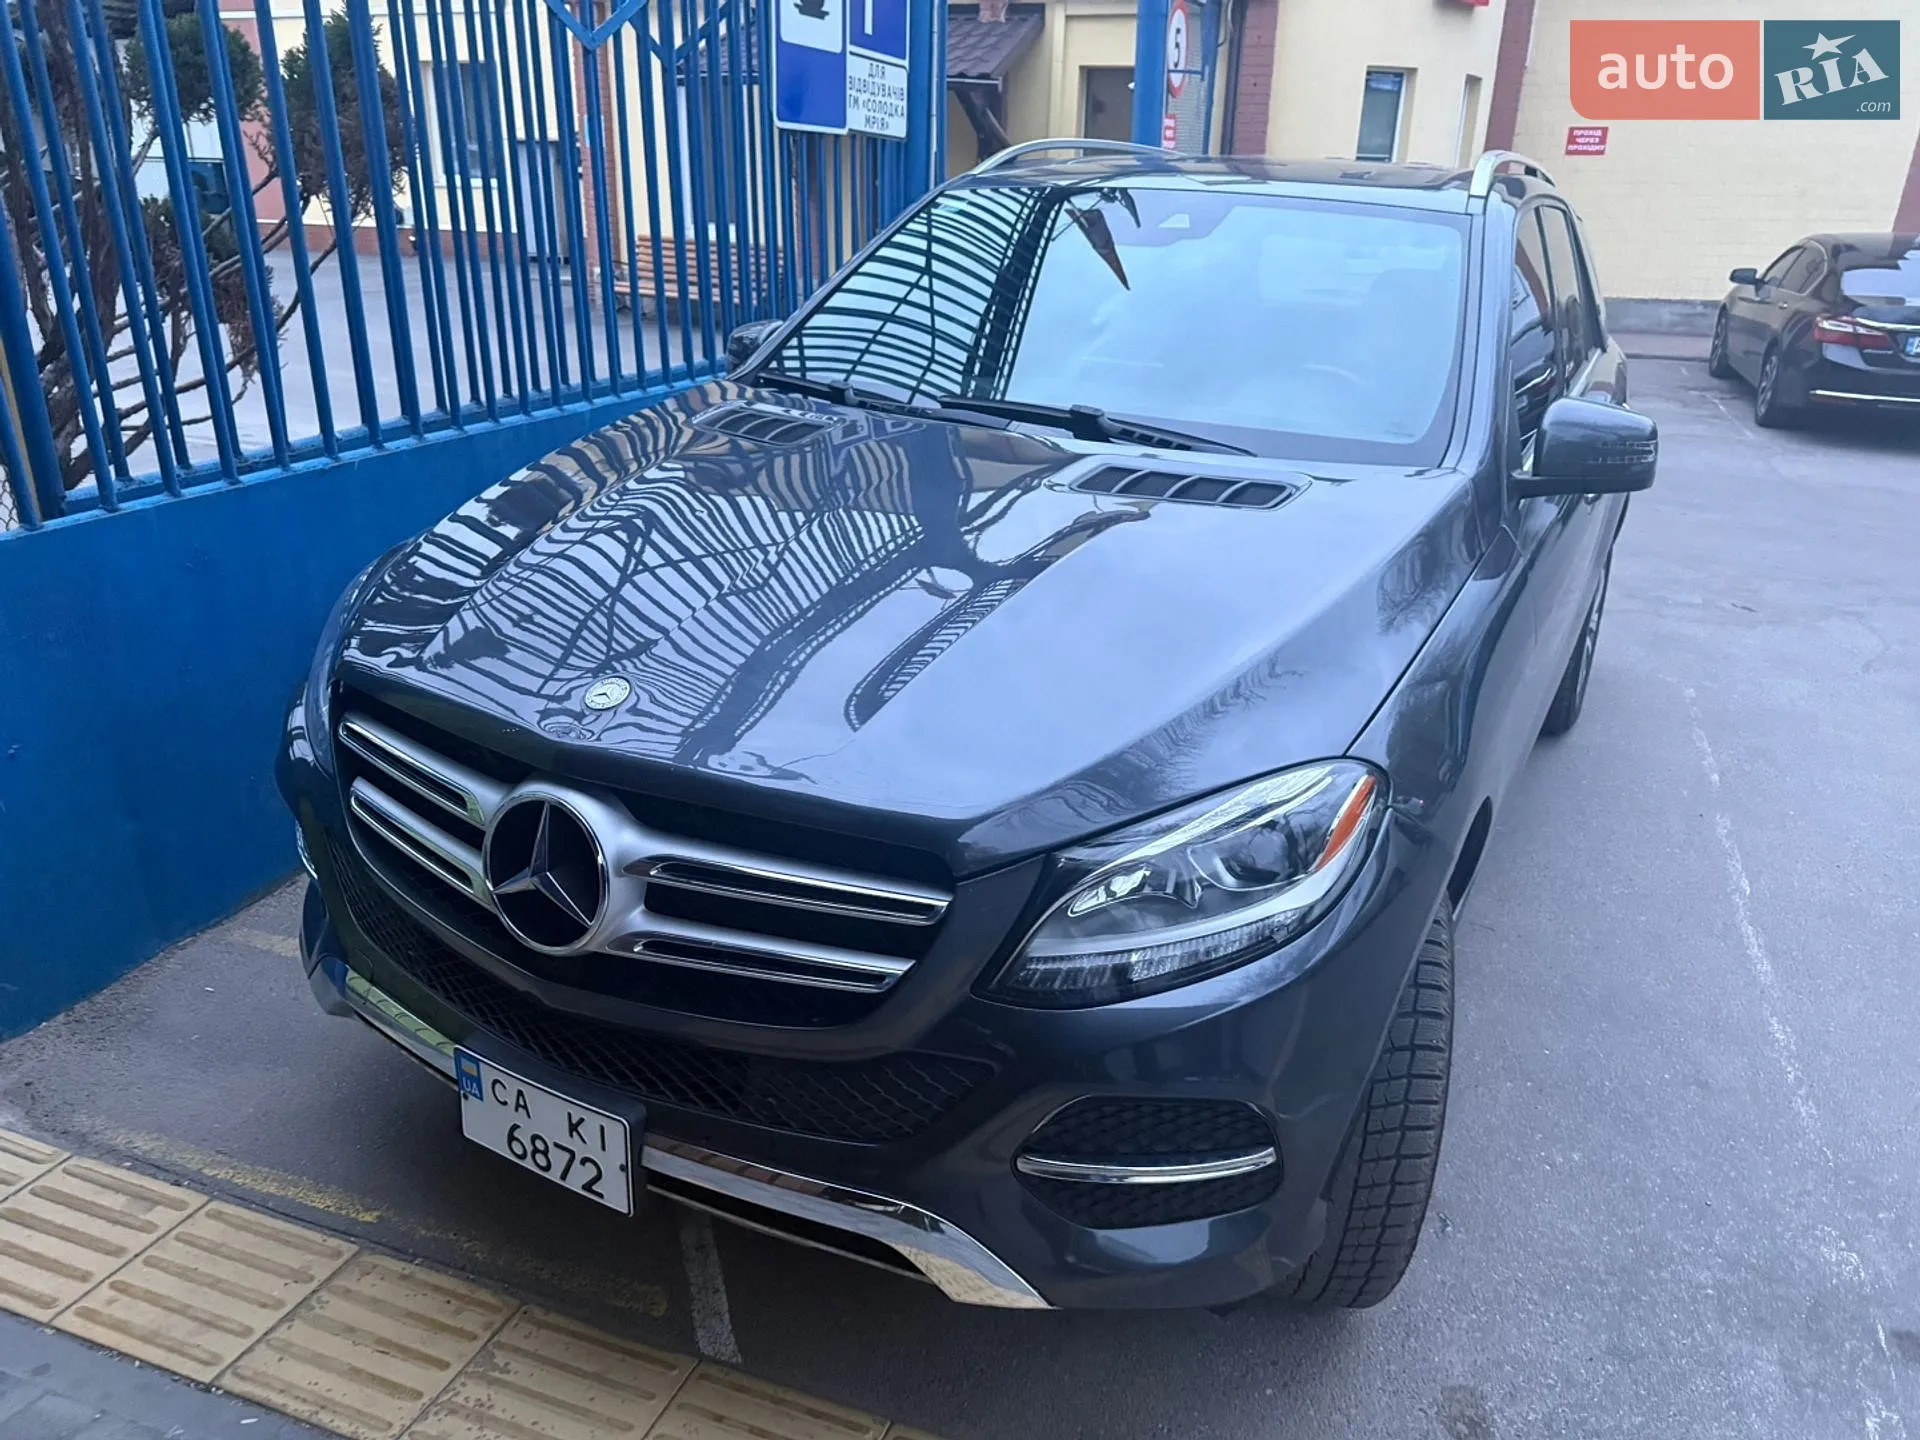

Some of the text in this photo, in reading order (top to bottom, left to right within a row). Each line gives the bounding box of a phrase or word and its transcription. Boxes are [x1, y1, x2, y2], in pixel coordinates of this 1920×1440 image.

[1174, 27, 1182, 68] 5
[868, 62, 886, 80] ДЛЯ
[848, 75, 905, 102] ВІДВІДУВАЧІВ
[462, 1077, 480, 1098] UA
[491, 1078, 607, 1152] CA KI
[507, 1123, 605, 1199] 6872
